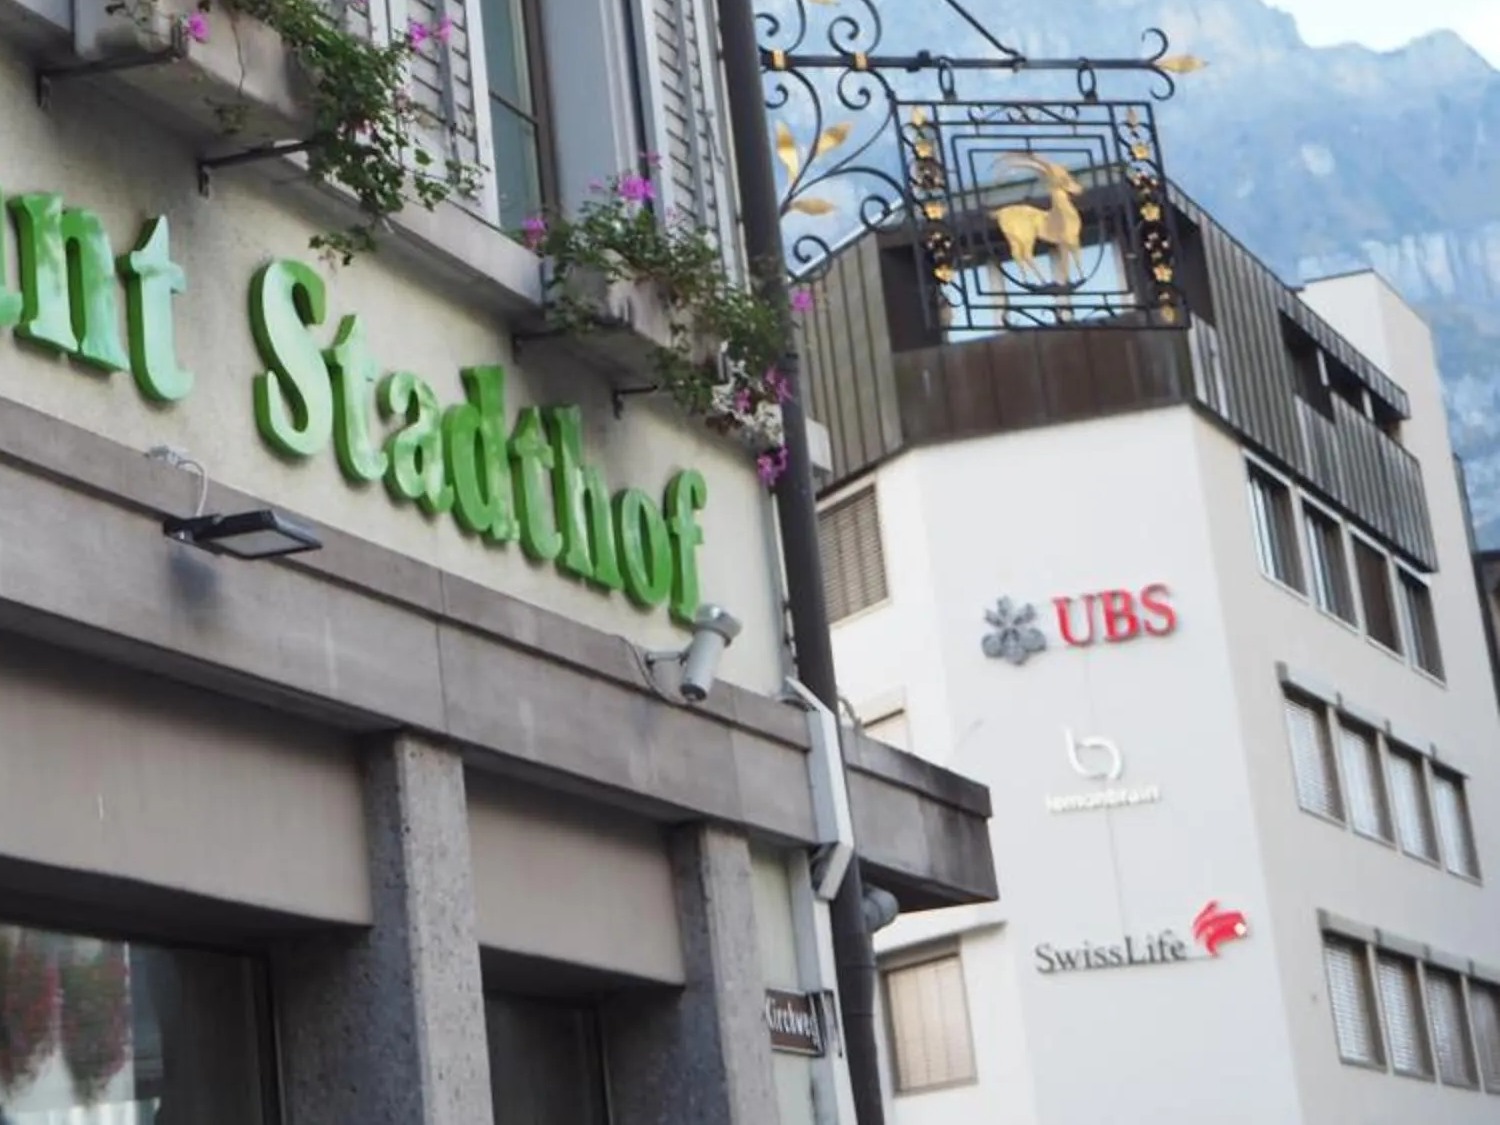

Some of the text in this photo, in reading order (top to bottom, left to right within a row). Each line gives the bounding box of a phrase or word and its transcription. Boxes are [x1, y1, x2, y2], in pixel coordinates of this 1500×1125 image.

[248, 257, 708, 633] Stadthof
[1052, 582, 1178, 648] UBS
[1034, 928, 1187, 974] SwissLife
